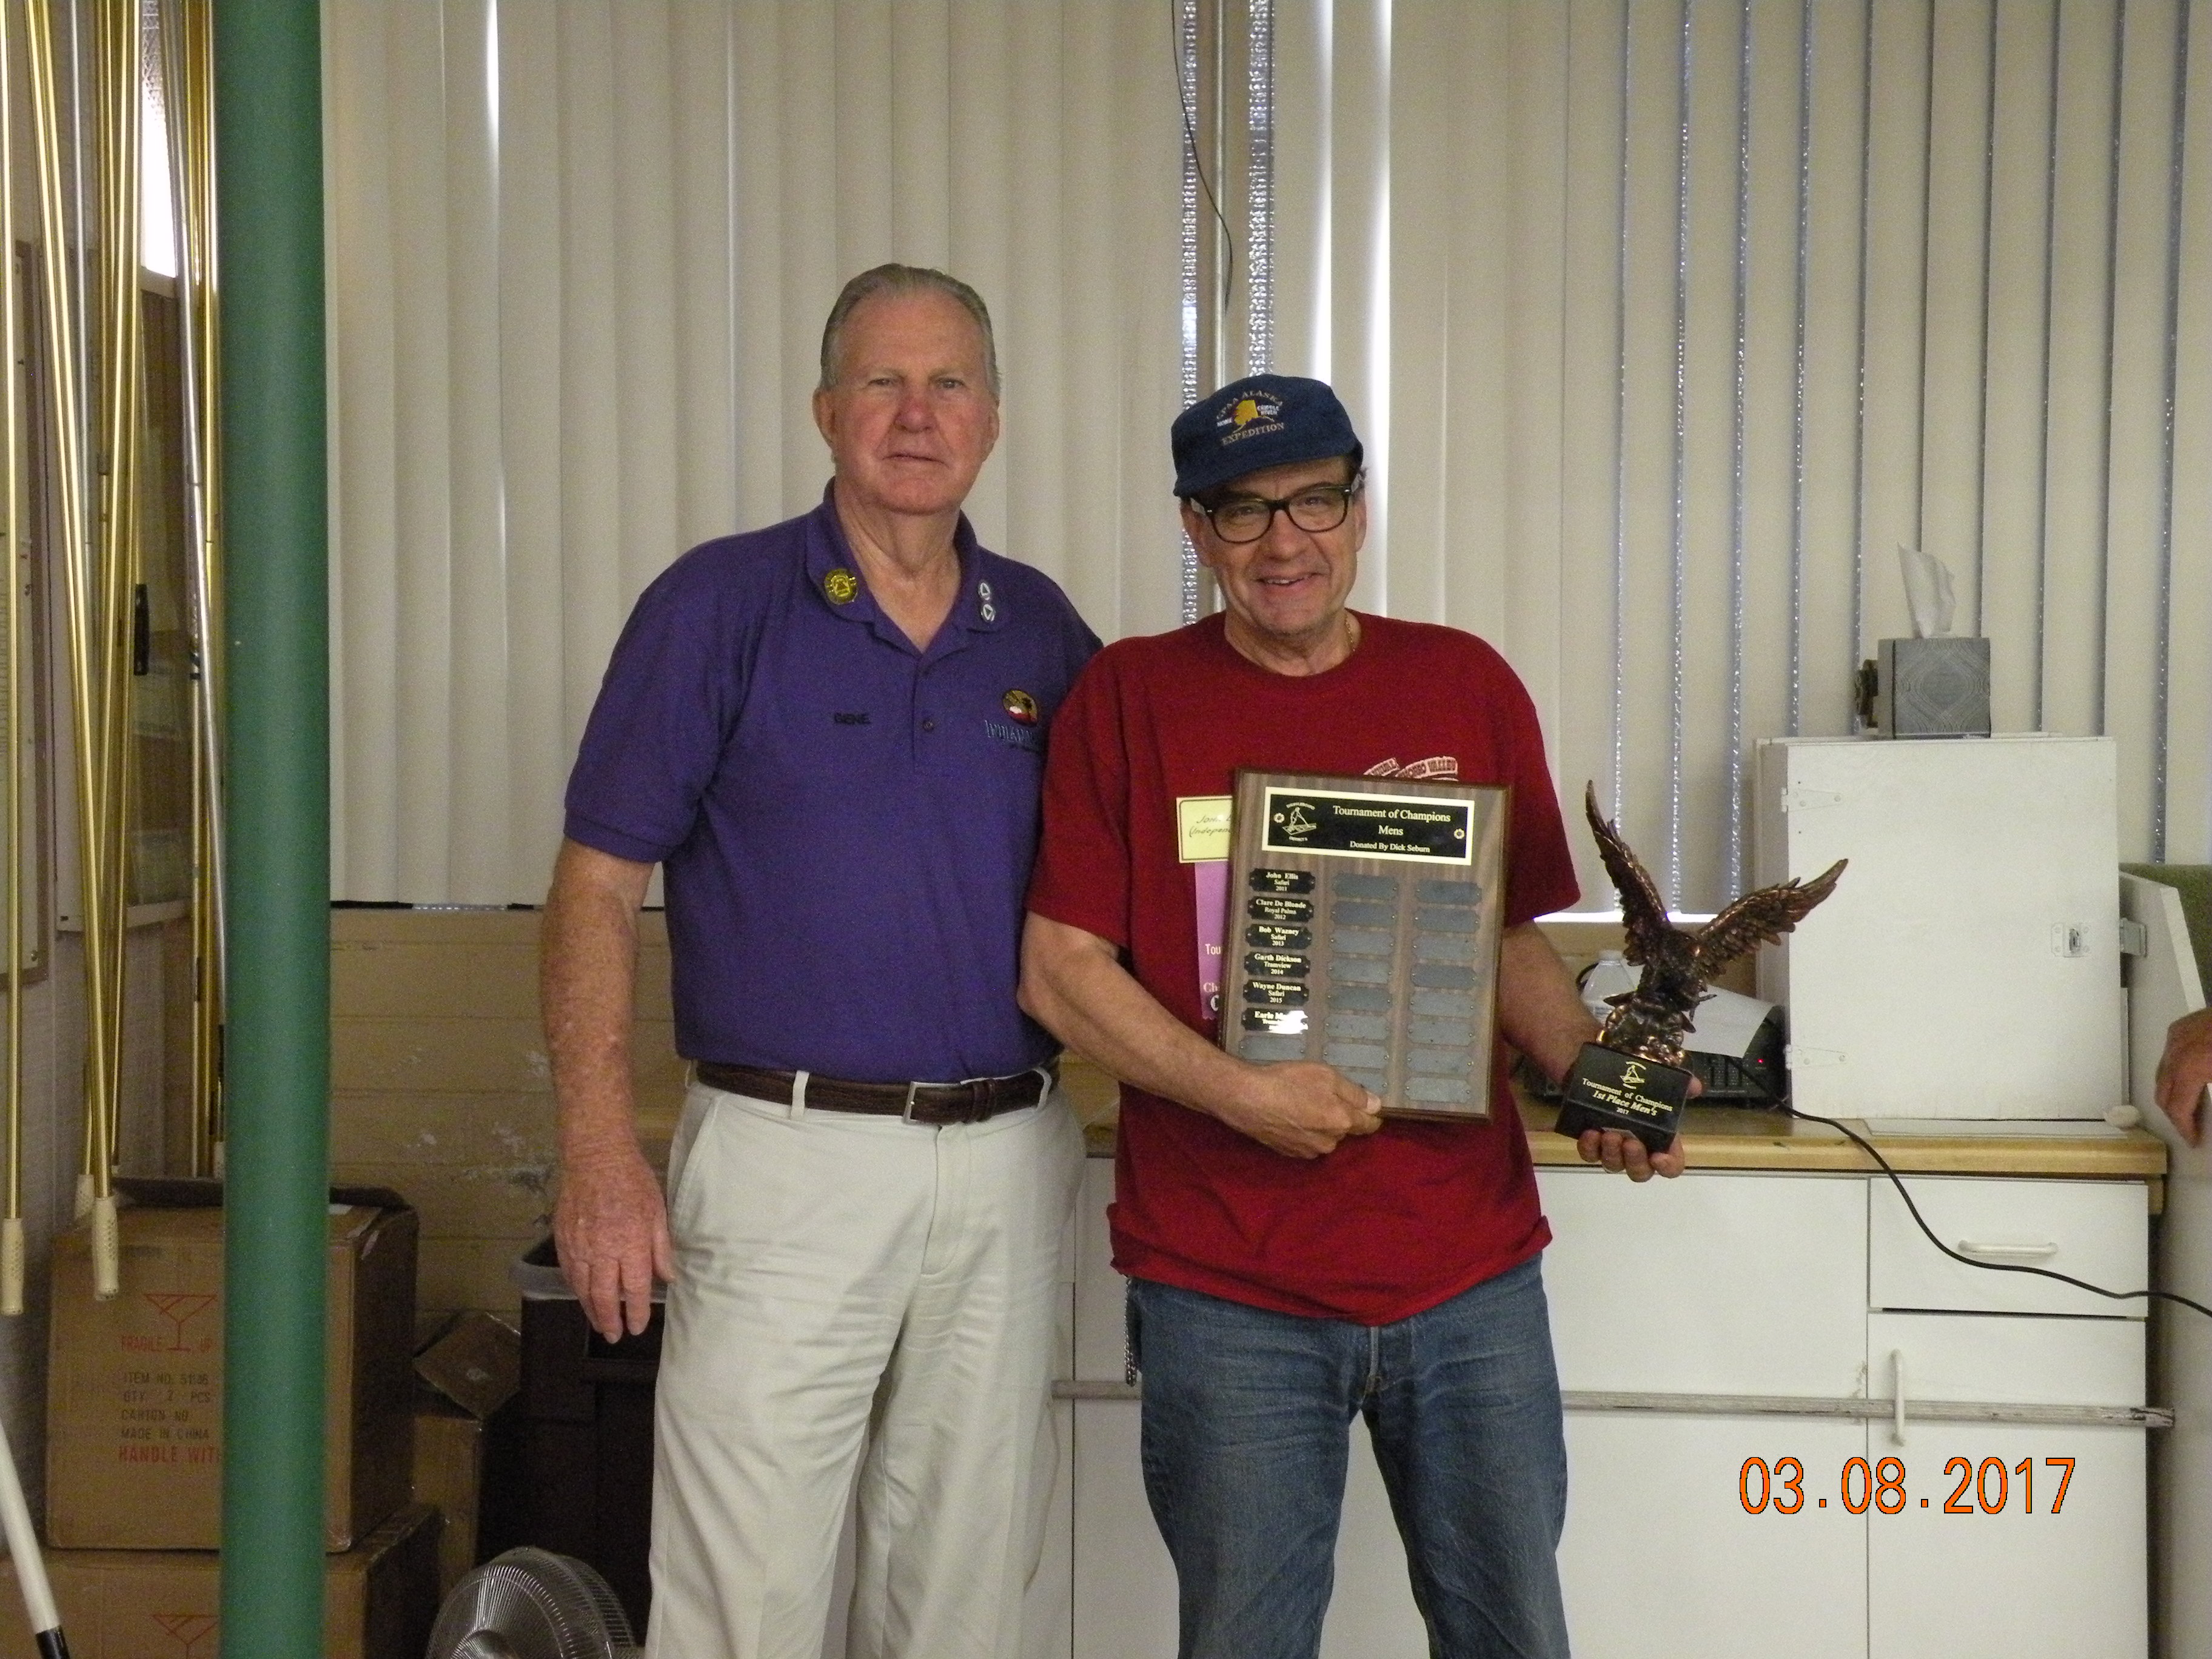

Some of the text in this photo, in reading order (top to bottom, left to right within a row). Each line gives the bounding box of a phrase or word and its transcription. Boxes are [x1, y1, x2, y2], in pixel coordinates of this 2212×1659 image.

[1242, 390, 1283, 406] ALASKA
[1222, 422, 1284, 445] EXPEDITION
[1333, 805, 1451, 823] Tournament of Champions
[1378, 825, 1404, 836] Mens
[1350, 840, 1430, 853] Donated By Dick Seburn
[1205, 943, 1222, 955] Tou
[1275, 954, 1302, 964] Dickson
[1202, 982, 1219, 993] Ch
[1252, 982, 1302, 992] Wayne Duncan
[1582, 1078, 1623, 1096] Tournament
[1635, 1094, 1674, 1112] Champions
[1592, 1090, 1658, 1117] 1st Place Men's
[1616, 1107, 1630, 1116] 2017
[124, 1372, 150, 1385] ITEM
[121, 1408, 166, 1422] CARTON
[121, 1427, 210, 1441] MADE IN CHINA
[118, 1445, 220, 1464] HANDLE WIT
